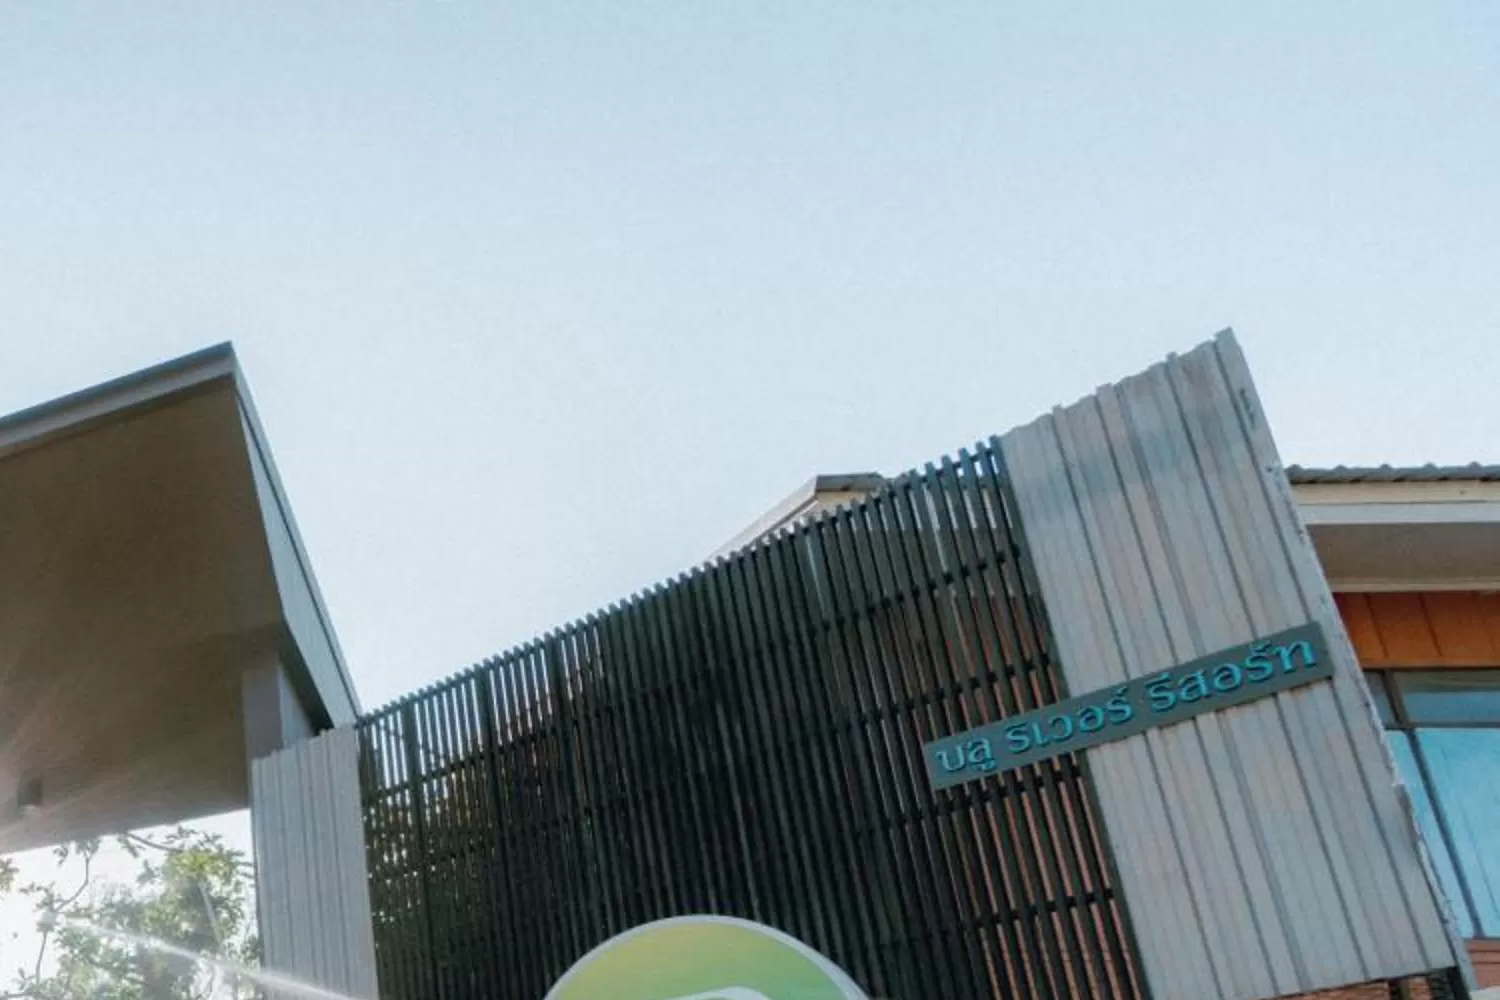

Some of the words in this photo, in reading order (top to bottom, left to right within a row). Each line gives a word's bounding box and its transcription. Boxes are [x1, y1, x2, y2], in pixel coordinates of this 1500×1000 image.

[936, 736, 995, 773] บลู
[1145, 636, 1317, 712] รีสอร์ท
